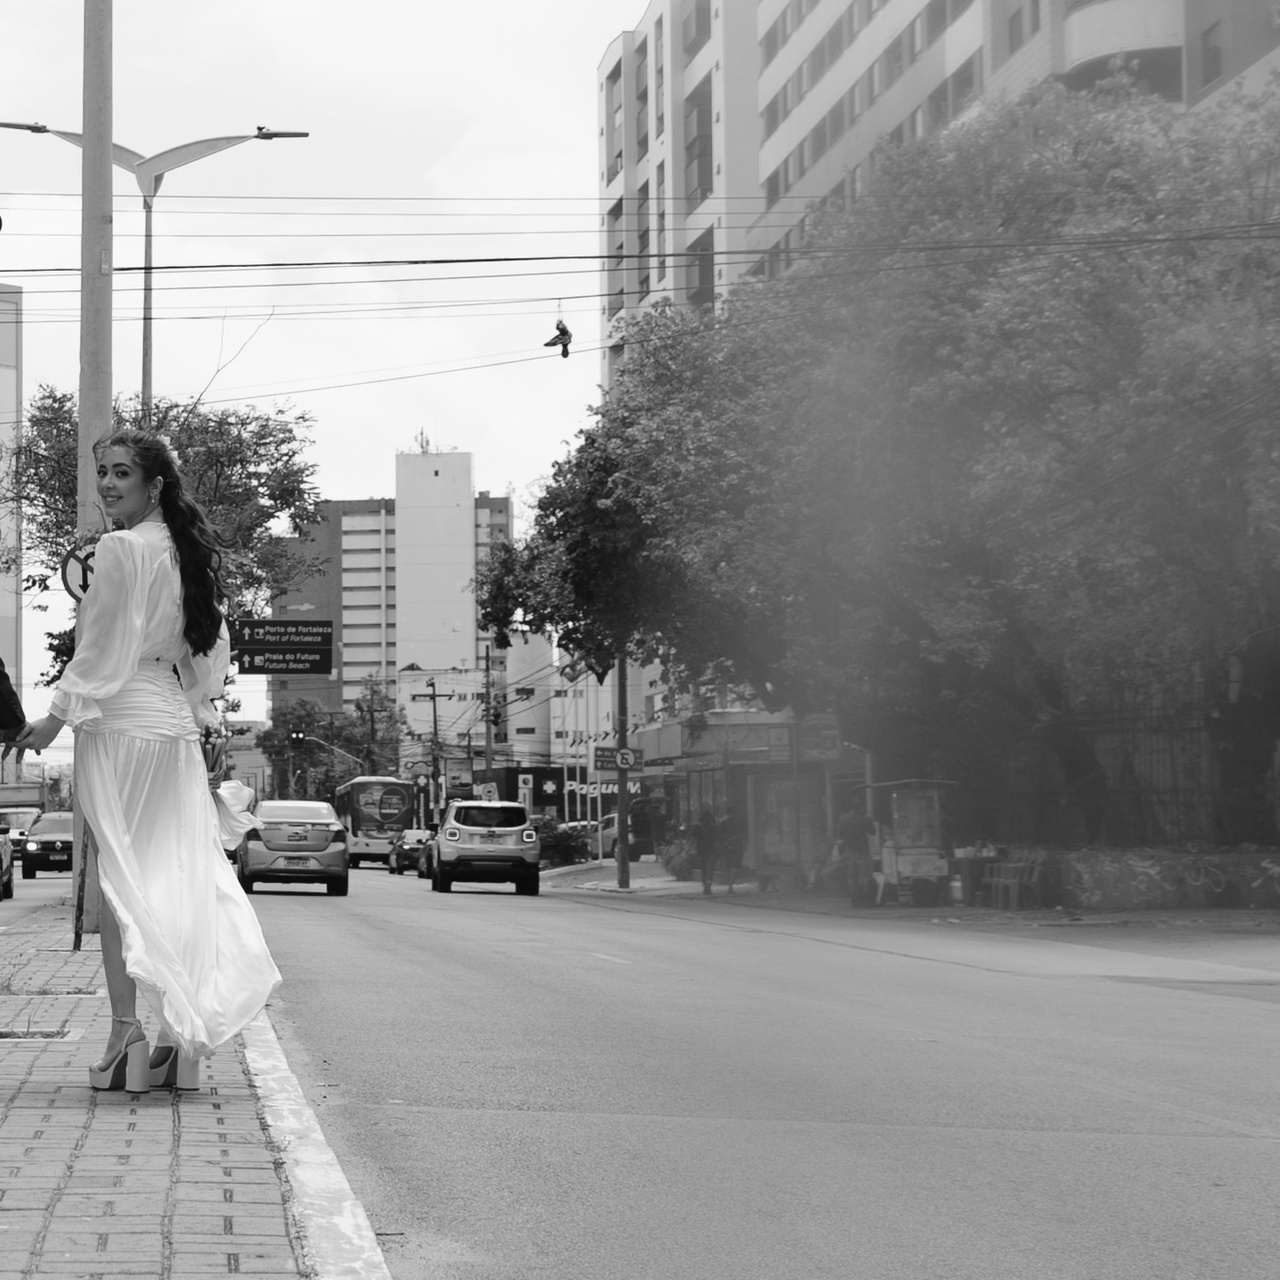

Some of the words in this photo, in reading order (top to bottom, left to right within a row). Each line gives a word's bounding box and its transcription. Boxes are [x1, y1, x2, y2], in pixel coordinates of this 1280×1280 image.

[264, 625, 285, 633] Porto
[286, 625, 296, 633] de
[298, 625, 332, 633] Fortaleza
[264, 634, 280, 642] Port
[281, 634, 290, 642] of
[290, 634, 322, 642] Fortaleza
[264, 652, 283, 660] Praia
[284, 652, 295, 660] do
[296, 652, 321, 660] Futuro
[264, 661, 287, 669] Futuro
[288, 661, 310, 669] Beach
